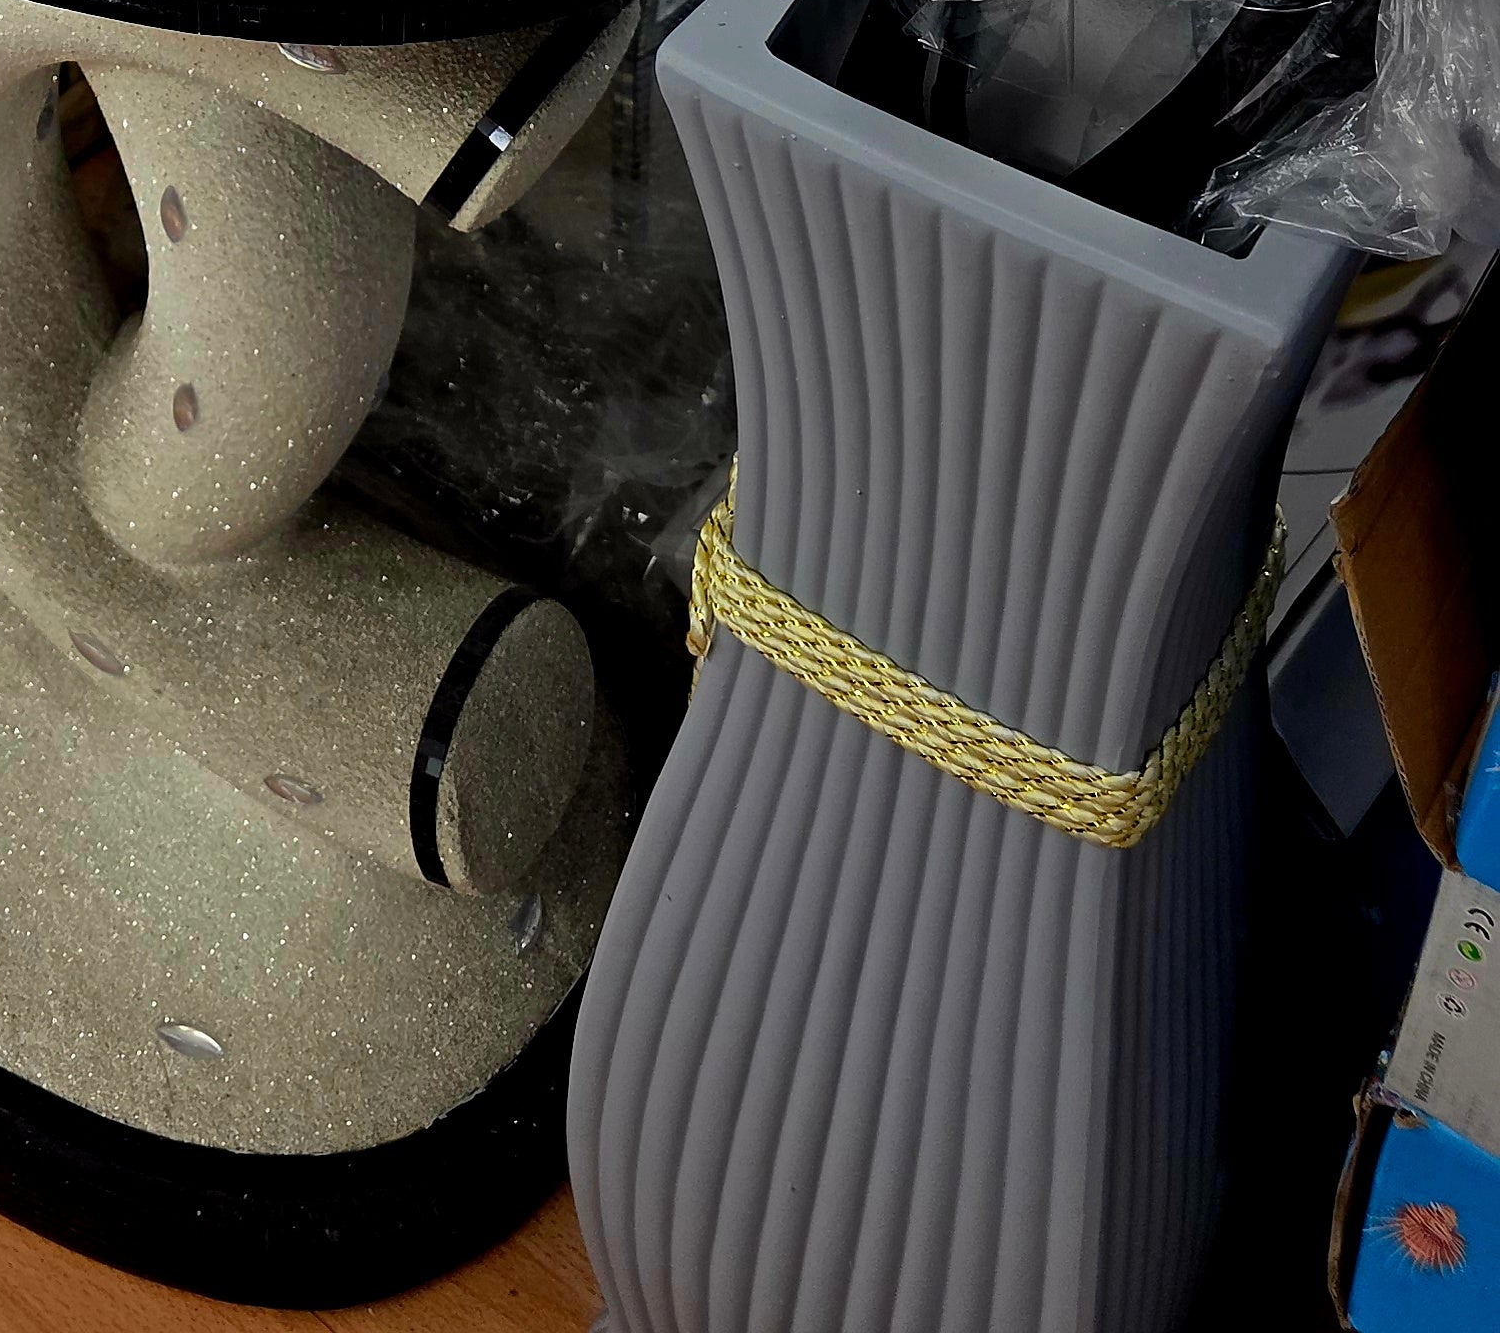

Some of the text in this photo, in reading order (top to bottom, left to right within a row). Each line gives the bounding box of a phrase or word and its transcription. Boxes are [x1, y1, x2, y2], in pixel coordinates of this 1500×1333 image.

[1414, 1030, 1446, 1102] MADE IN CHINA
